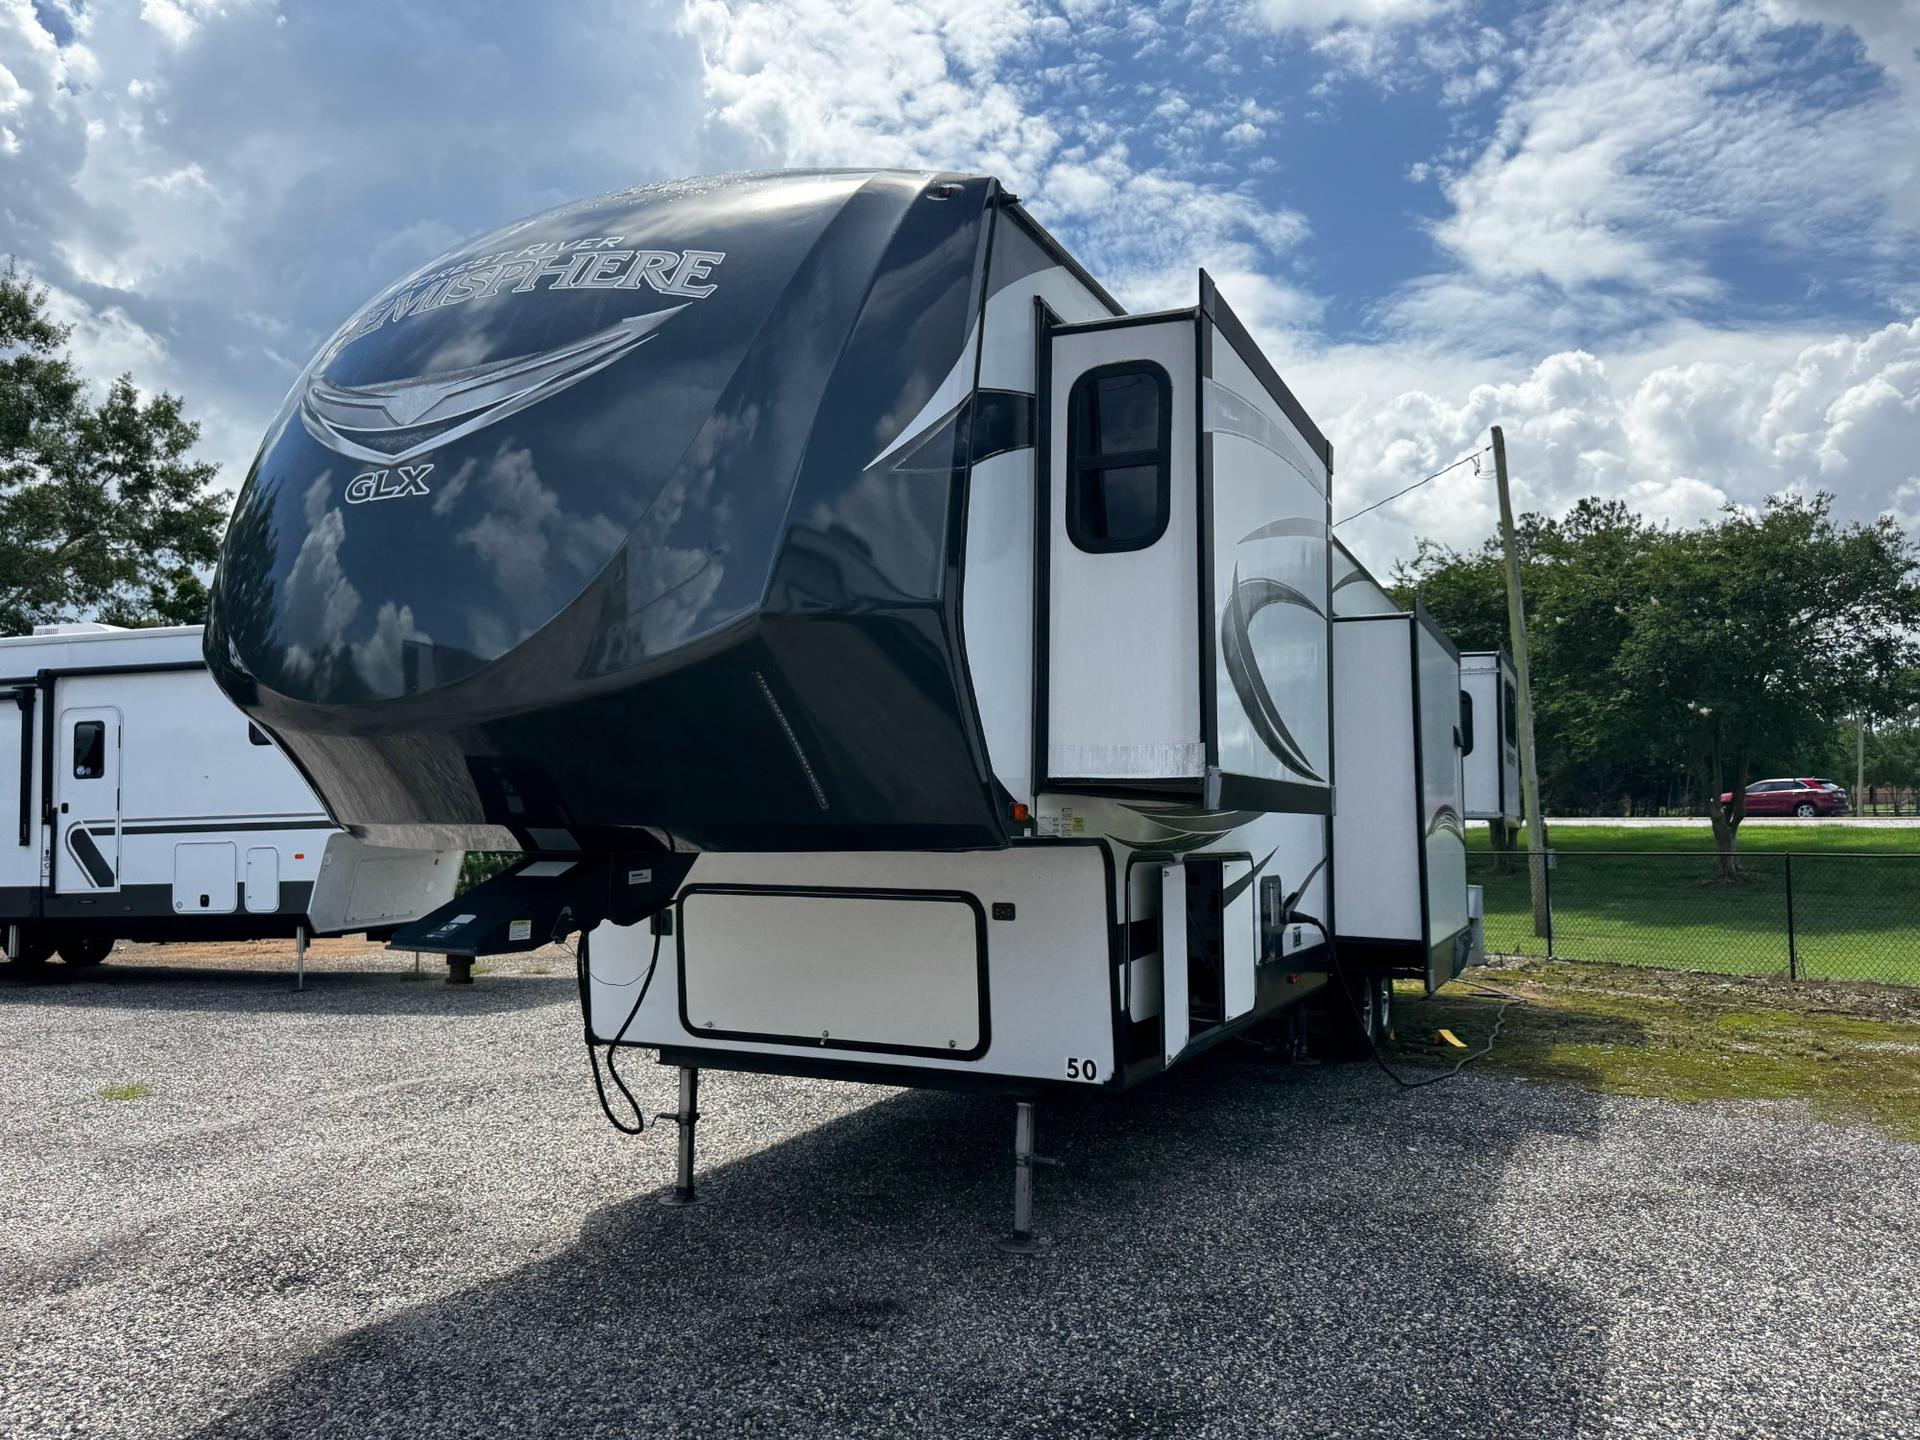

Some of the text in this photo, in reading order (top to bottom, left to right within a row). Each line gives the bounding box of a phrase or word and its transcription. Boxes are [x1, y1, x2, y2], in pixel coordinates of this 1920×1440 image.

[516, 236, 625, 258] RIVER
[335, 250, 727, 353] EMISPHERE
[344, 463, 435, 505] GLX
[1066, 1057, 1097, 1081] 50
